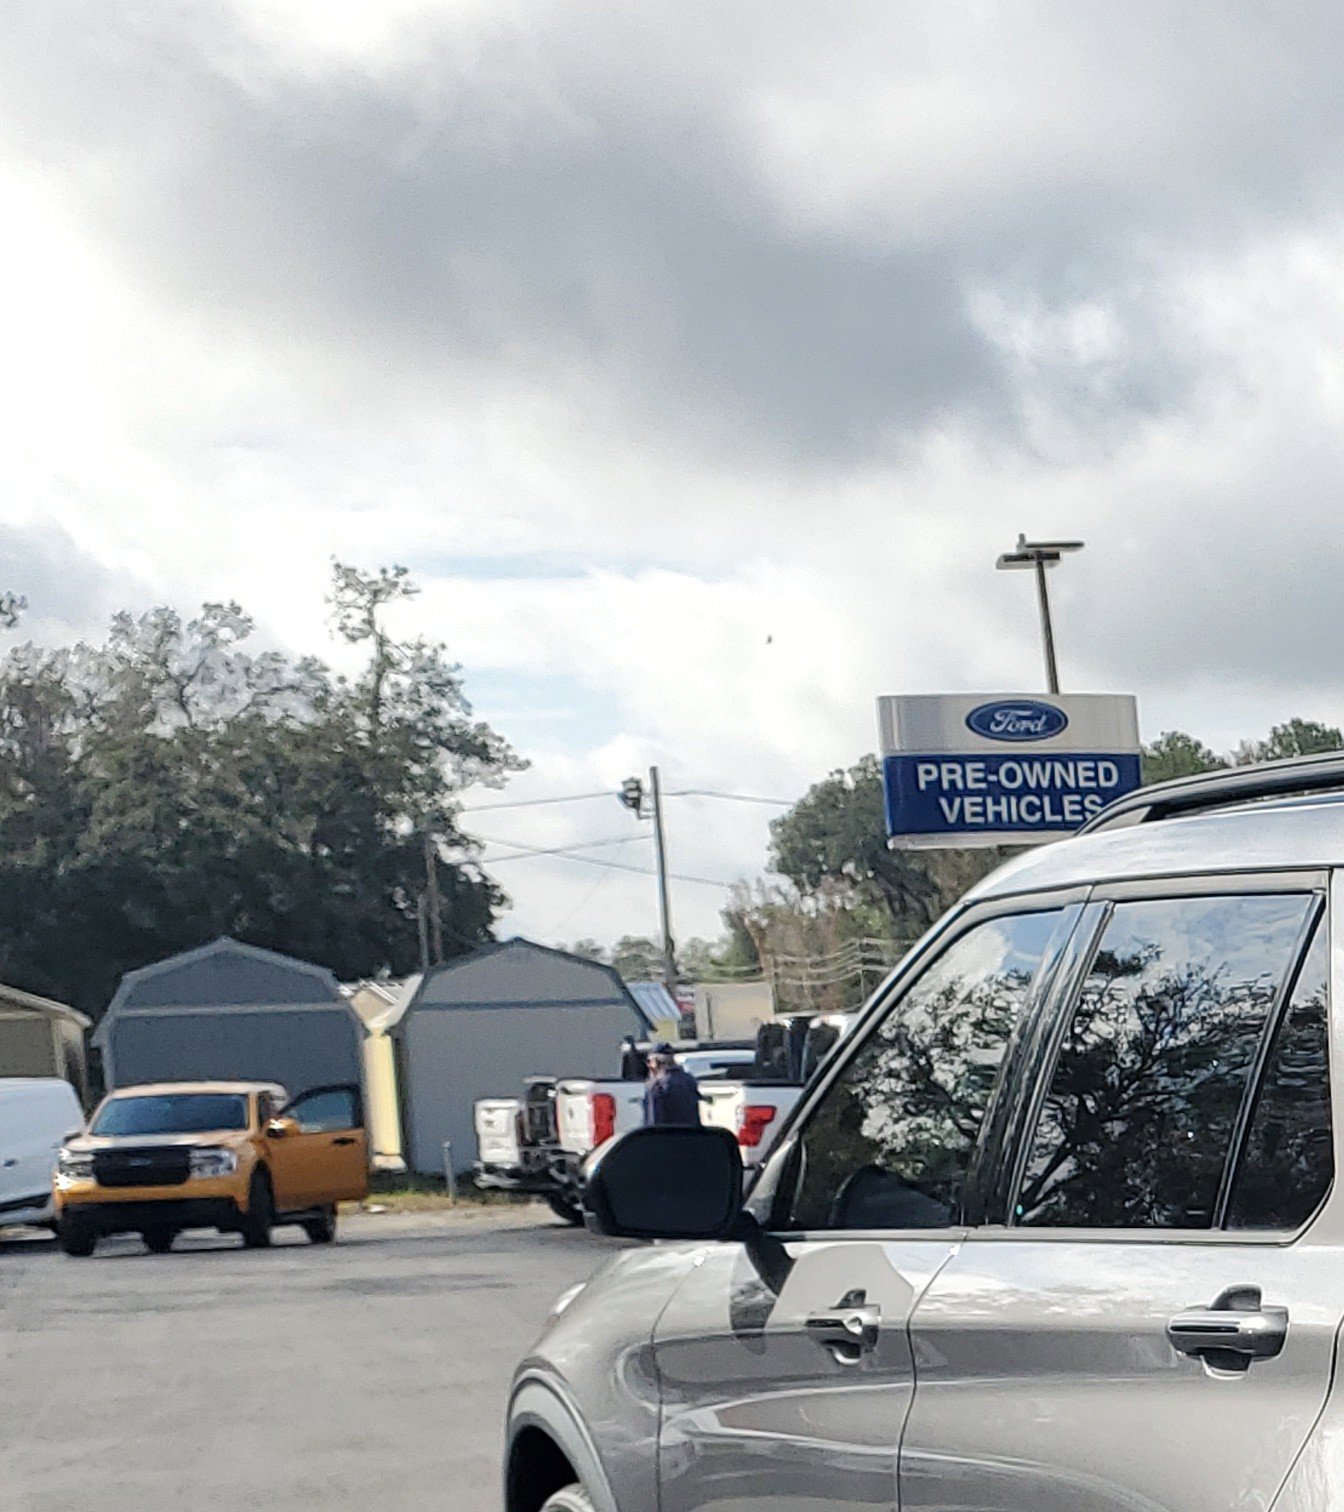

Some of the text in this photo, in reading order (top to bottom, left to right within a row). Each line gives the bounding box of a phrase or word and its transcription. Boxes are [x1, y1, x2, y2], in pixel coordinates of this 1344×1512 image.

[989, 709, 1048, 733] Ford
[916, 760, 1120, 791] PRE-OWNED
[938, 794, 1101, 824] VEHICLES
